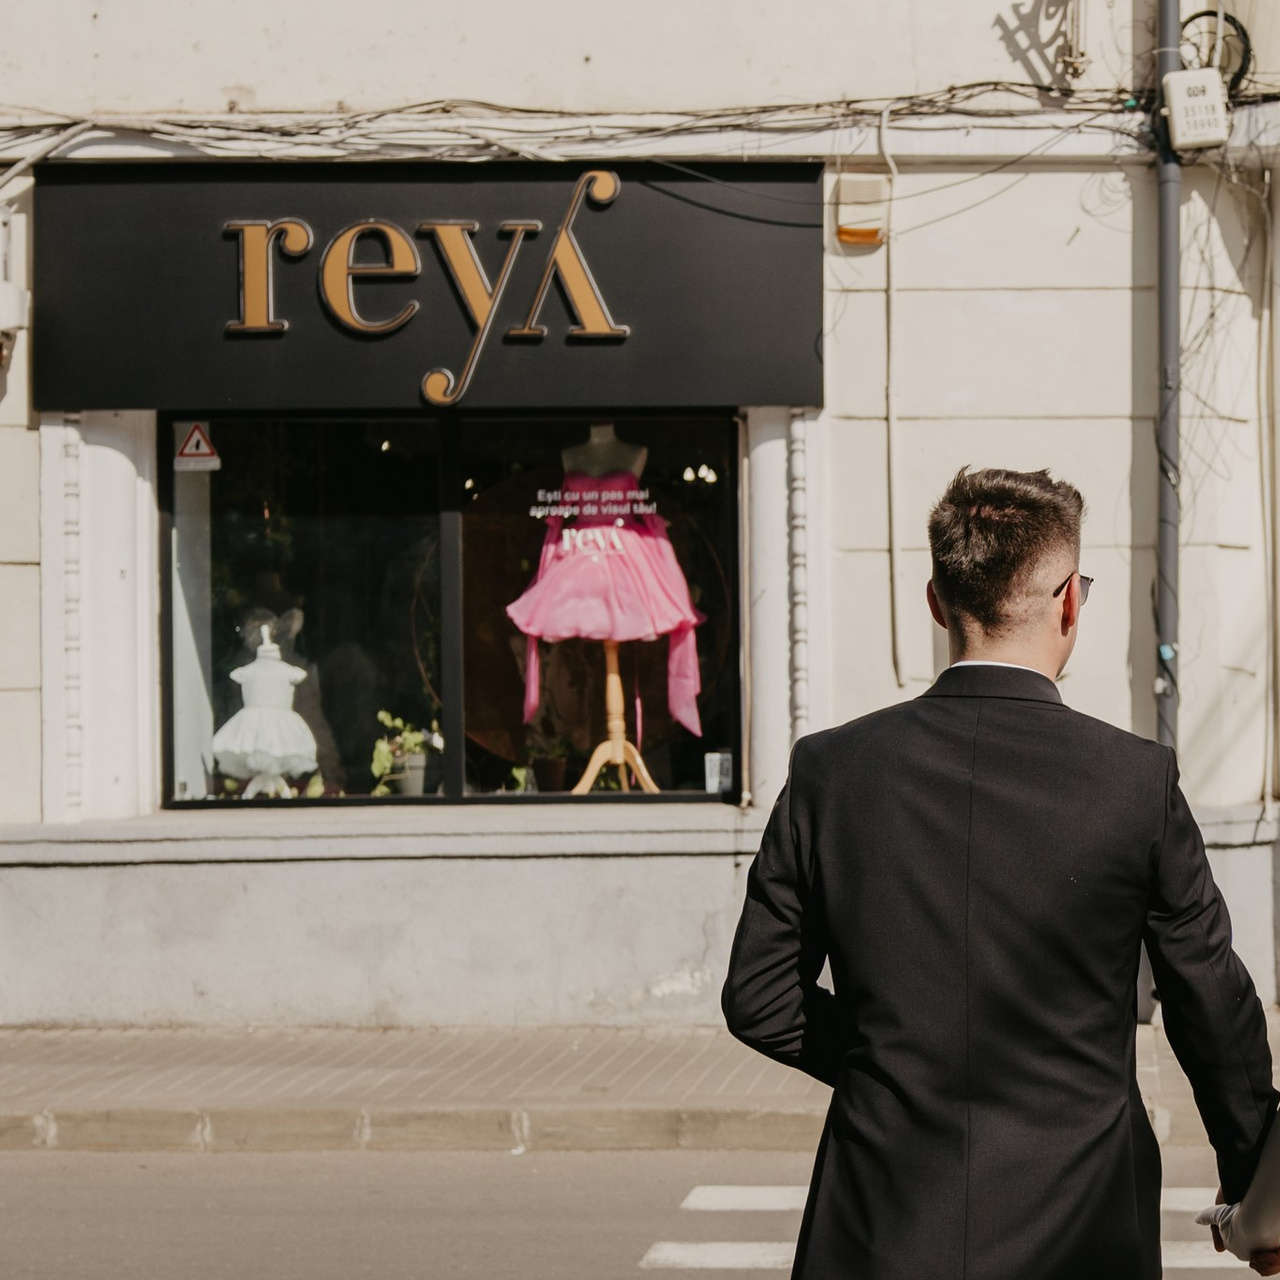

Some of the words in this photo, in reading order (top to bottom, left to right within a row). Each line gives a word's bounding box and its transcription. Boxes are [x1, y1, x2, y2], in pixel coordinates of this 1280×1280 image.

[564, 490, 580, 501] cu
[582, 490, 599, 501] un
[601, 490, 624, 503] pas
[626, 488, 650, 501] mai
[582, 504, 598, 515] de
[600, 502, 631, 515] visul
